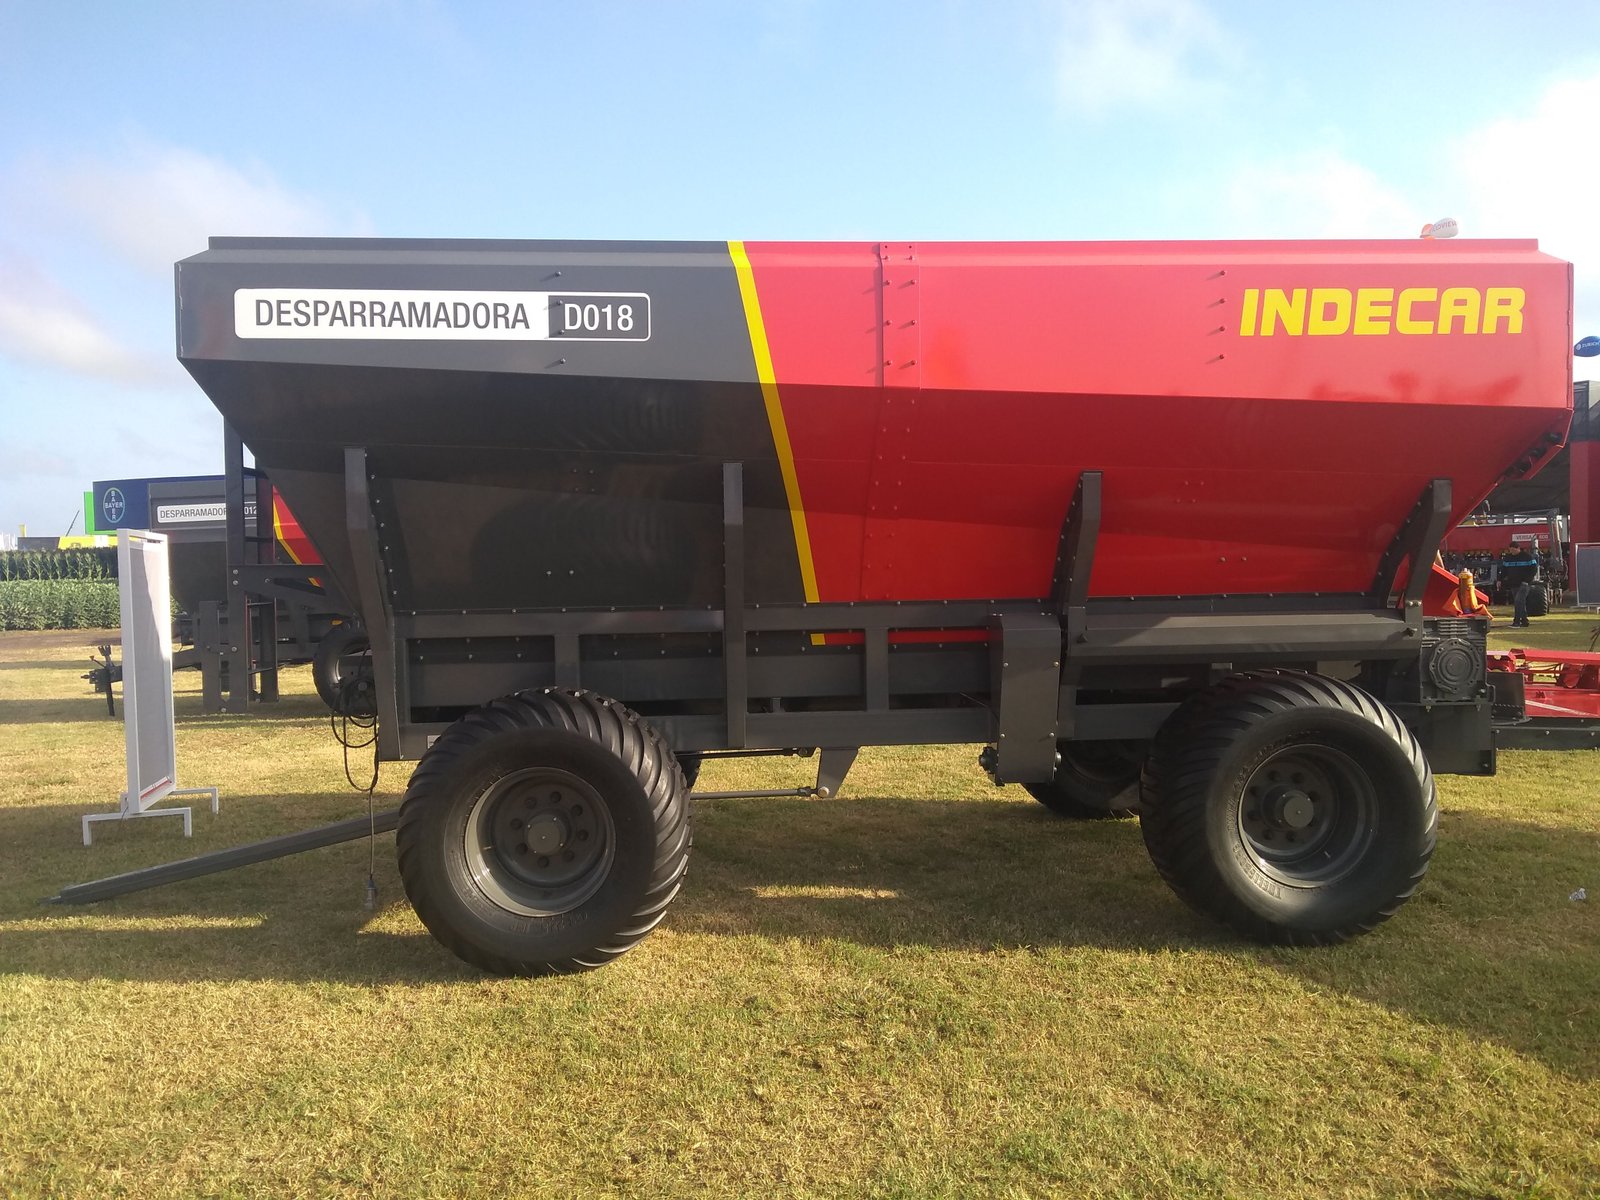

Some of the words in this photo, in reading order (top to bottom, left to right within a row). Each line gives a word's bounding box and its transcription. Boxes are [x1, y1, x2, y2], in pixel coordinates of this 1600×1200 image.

[255, 299, 530, 330] DESPARRAMADORA
[563, 303, 634, 332] D018
[1239, 287, 1526, 337] INDECAR
